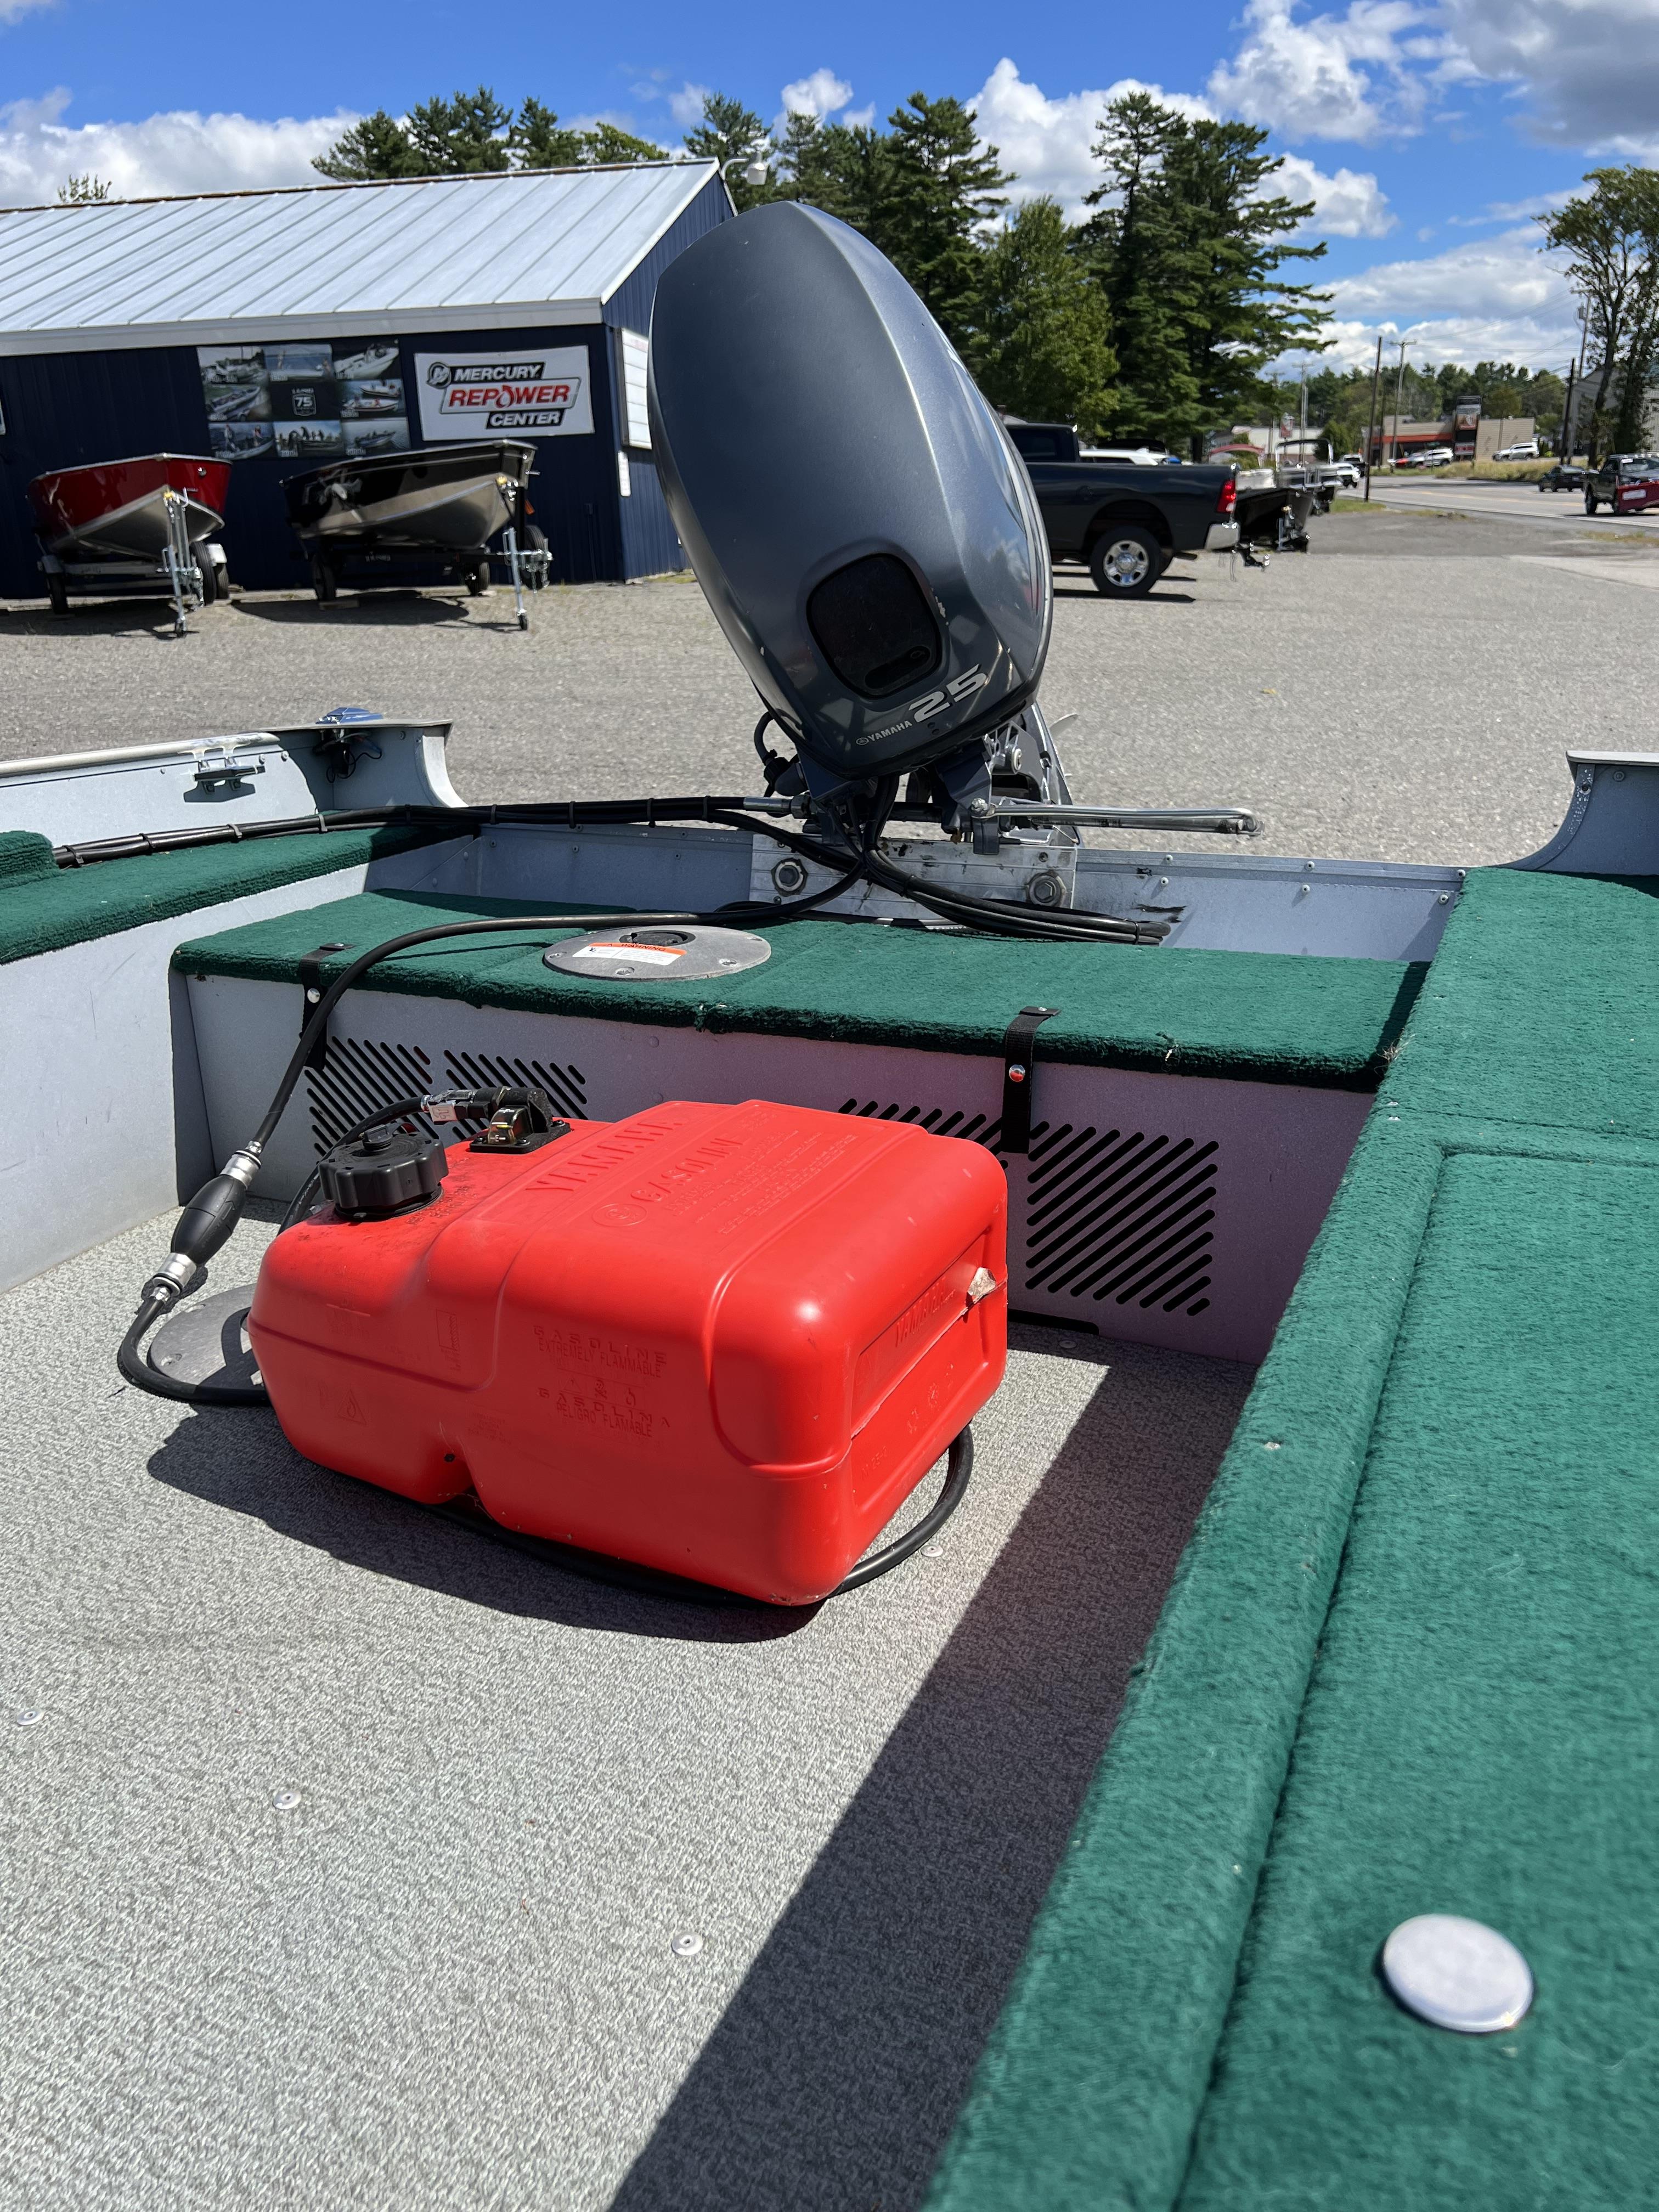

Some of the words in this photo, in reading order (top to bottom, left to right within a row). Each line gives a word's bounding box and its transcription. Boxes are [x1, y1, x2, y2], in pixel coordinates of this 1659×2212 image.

[454, 365, 541, 381] MERCURY
[294, 396, 313, 408] 75
[449, 385, 571, 409] REPOWER
[490, 412, 561, 426] CENTER
[908, 663, 987, 723] 25
[867, 720, 913, 742] YAMAHA
[620, 943, 668, 952] WARNING
[525, 1117, 685, 1192] YAMAHA
[533, 1325, 667, 1365] GASOLINE
[538, 1337, 595, 1363] EXTREMELY
[600, 1351, 662, 1378] FLAMMABLE
[556, 1401, 597, 1425] PELIGRO
